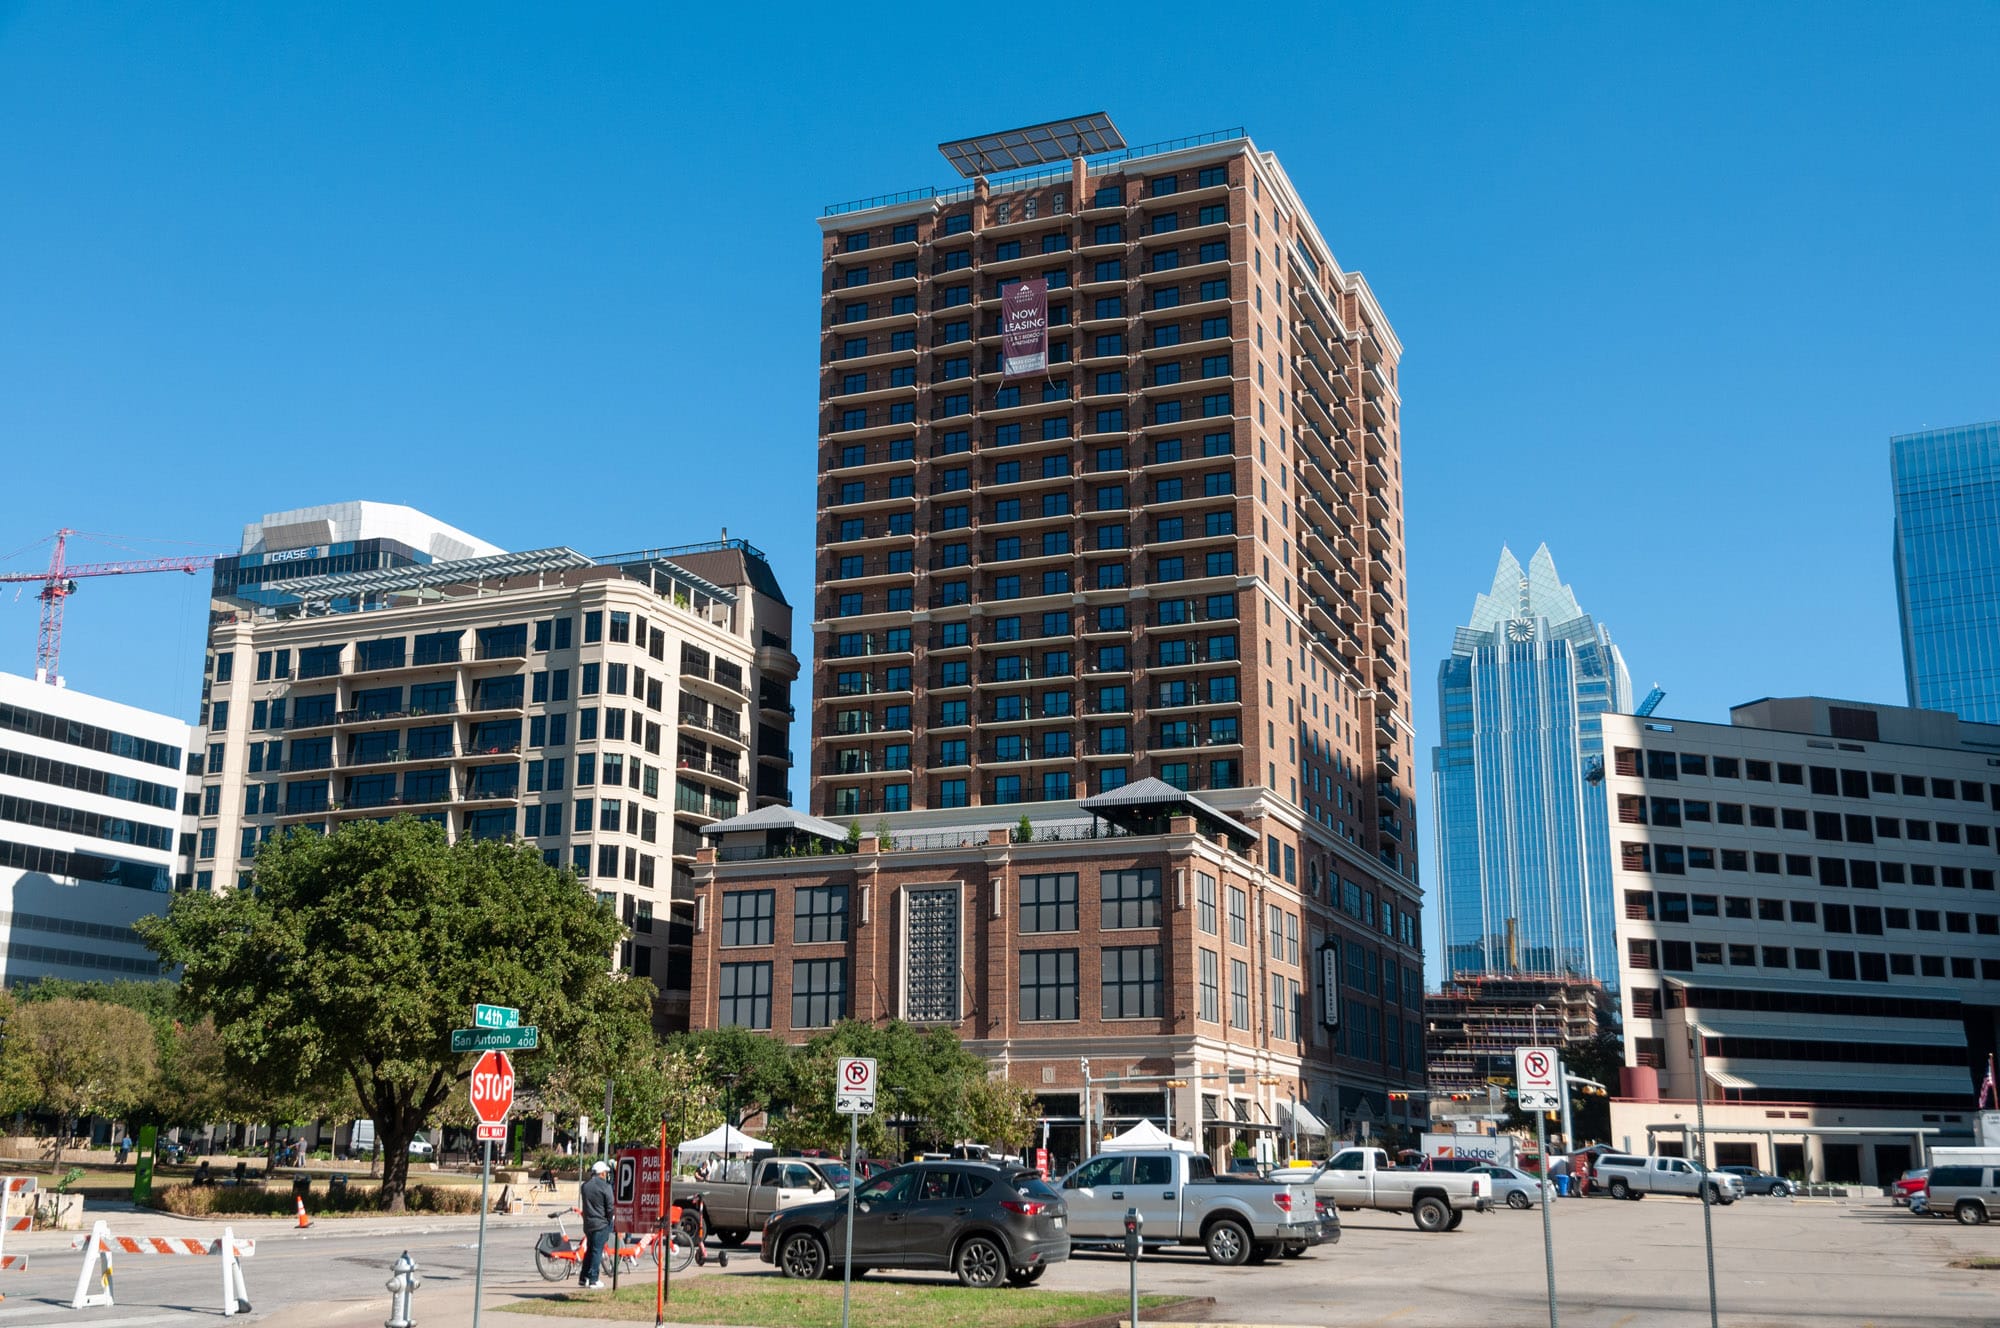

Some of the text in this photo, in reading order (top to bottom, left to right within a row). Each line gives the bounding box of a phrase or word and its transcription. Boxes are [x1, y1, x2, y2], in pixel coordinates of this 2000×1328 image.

[1012, 308, 1038, 320] NOW
[1005, 318, 1045, 333] LEASING
[272, 549, 307, 562] CHASE
[485, 1008, 503, 1026] 4th
[510, 1011, 518, 1019] ST
[454, 1028, 535, 1047] San Antonio ST 400
[474, 1072, 512, 1102] STOP
[480, 1127, 504, 1137] ALL WAY
[1522, 1140, 1538, 1148] ATM
[1455, 1146, 1499, 1159] Budge
[642, 1156, 665, 1168] PUBL
[620, 1163, 632, 1198] P
[642, 1170, 670, 1182] PARKG
